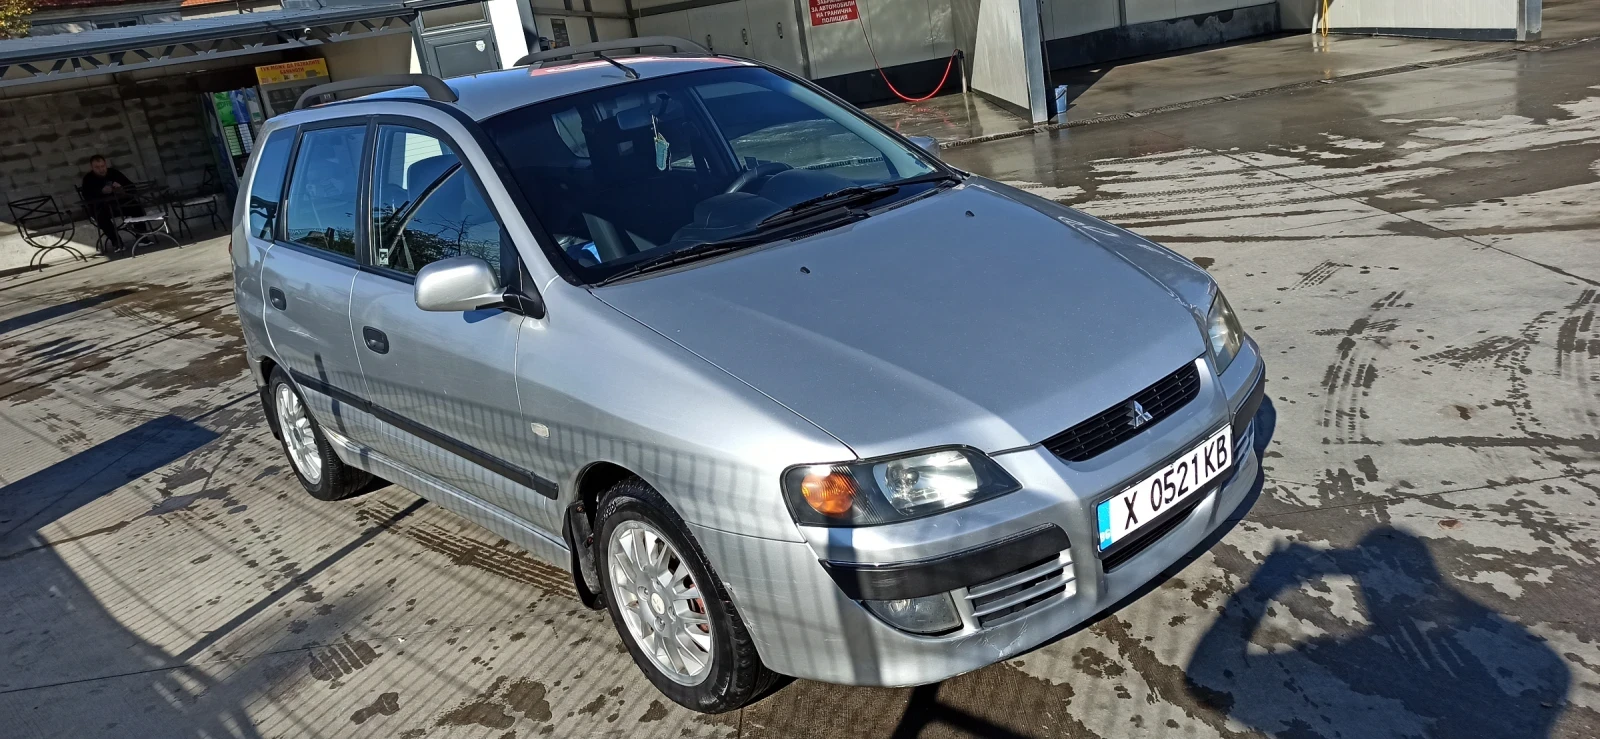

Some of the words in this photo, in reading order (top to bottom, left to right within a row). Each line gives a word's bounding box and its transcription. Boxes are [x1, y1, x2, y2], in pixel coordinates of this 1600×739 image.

[819, 1, 856, 11] АВТОМОБИЛИ
[825, 7, 852, 16] ГРАНИЧНА
[822, 15, 848, 23] ПОЛИЦИЯ
[1124, 491, 1138, 530] X
[1150, 453, 1198, 511] 0521
[1204, 435, 1227, 478] KB
